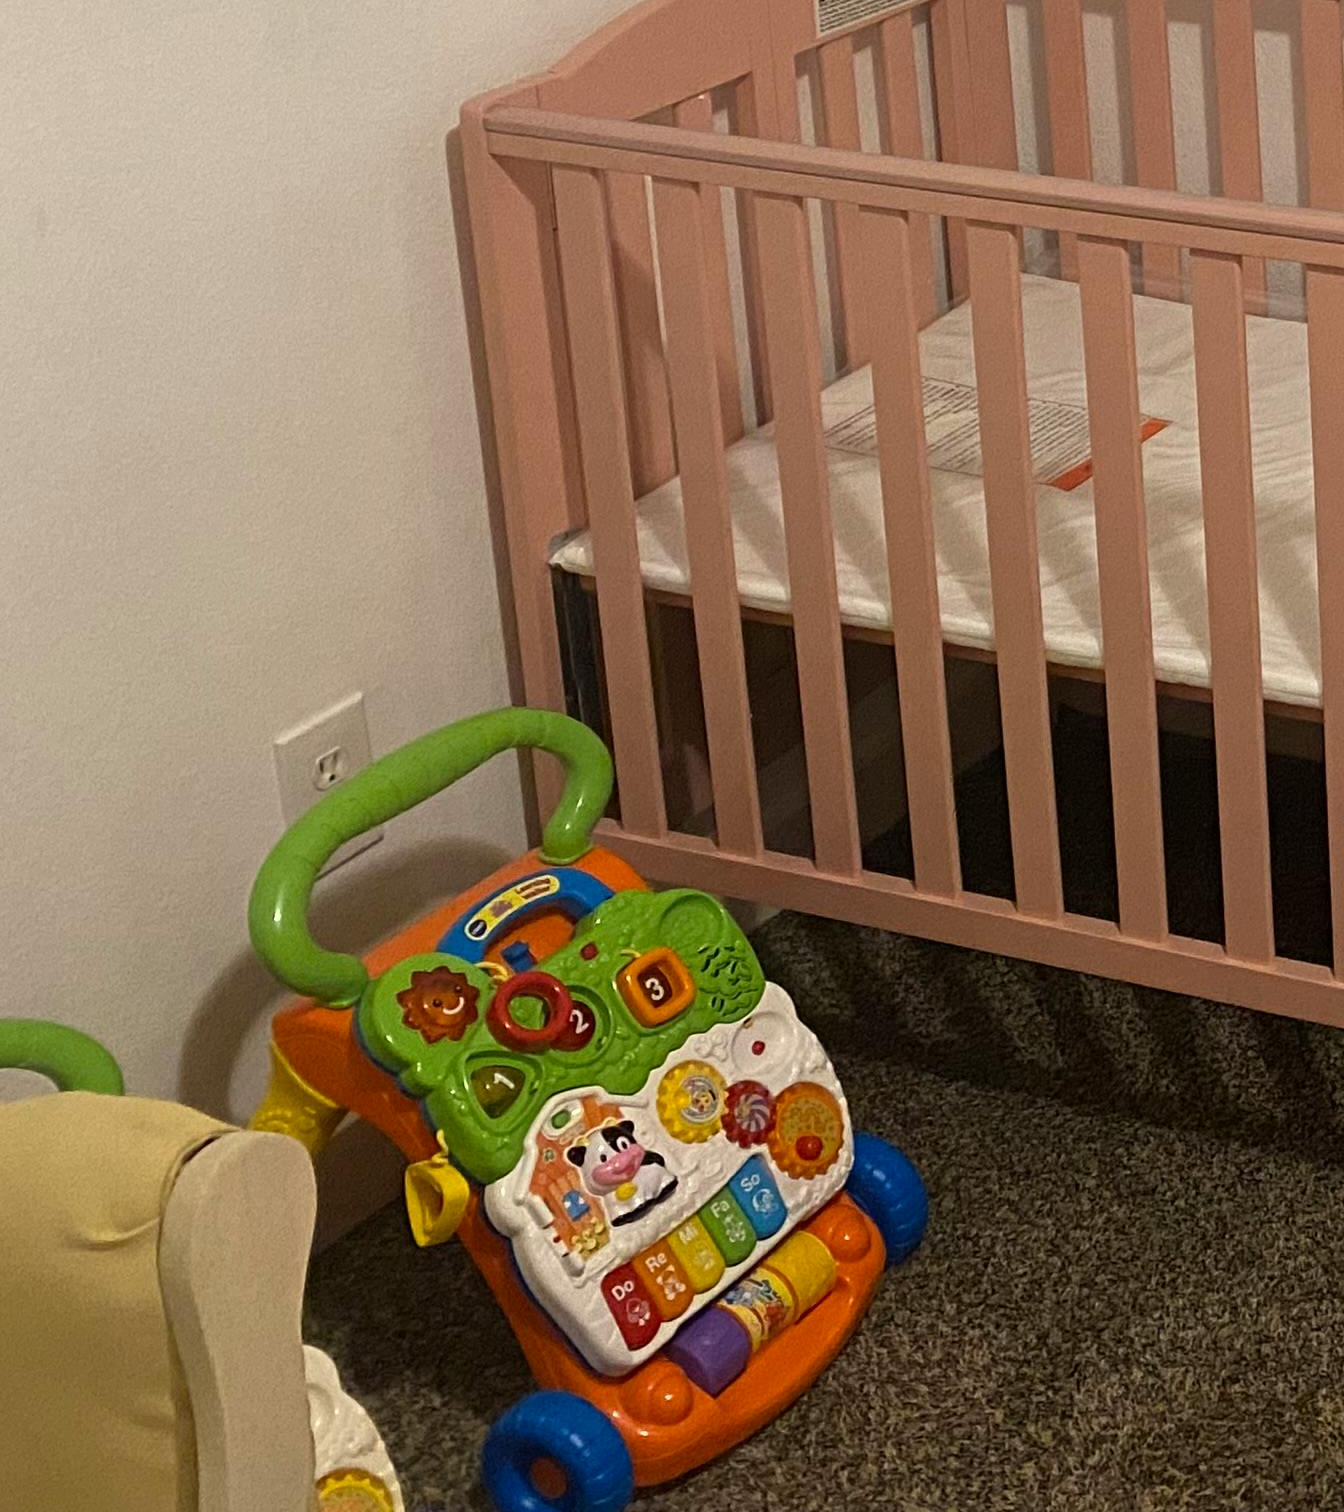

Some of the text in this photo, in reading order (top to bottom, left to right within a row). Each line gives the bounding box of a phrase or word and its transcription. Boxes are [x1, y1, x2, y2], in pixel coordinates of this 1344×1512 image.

[645, 977, 665, 1001] 3
[569, 1009, 590, 1034] 2
[493, 1073, 515, 1090] 1
[740, 1174, 761, 1192] So
[710, 1200, 730, 1218] Fa
[645, 1251, 667, 1273] Re
[611, 1280, 635, 1301] Do
